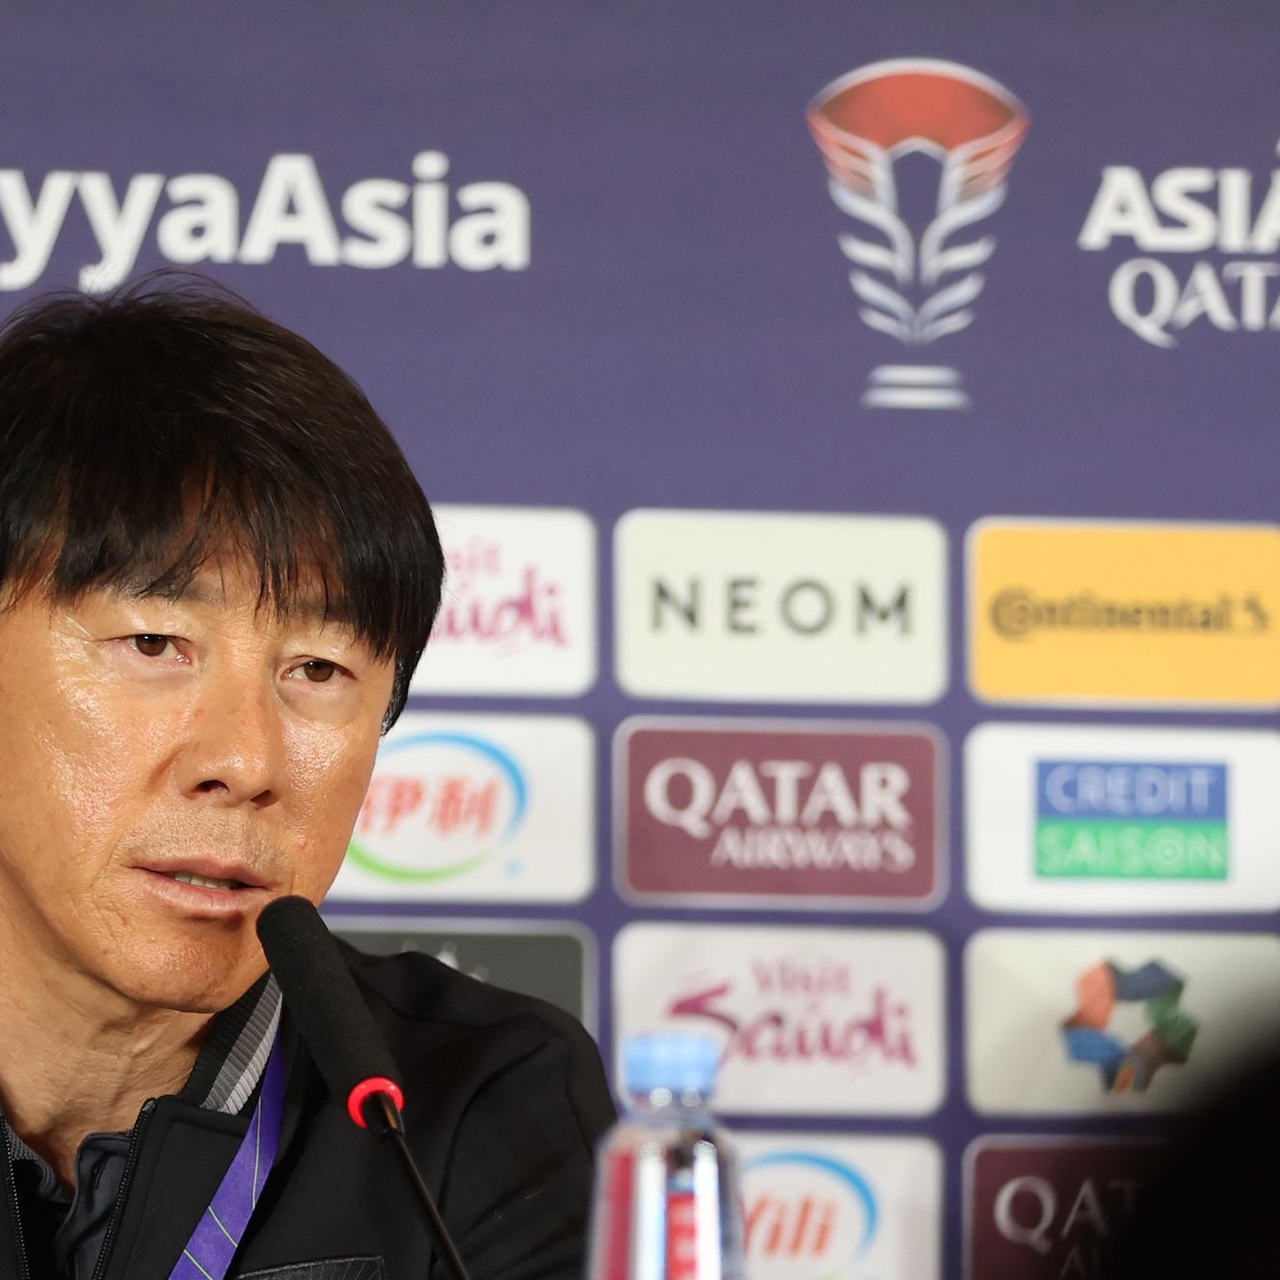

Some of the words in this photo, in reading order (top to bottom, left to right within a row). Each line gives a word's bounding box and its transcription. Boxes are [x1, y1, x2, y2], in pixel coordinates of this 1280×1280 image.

[647, 574, 914, 638] NEOM
[989, 585, 1235, 642] Continental
[642, 756, 913, 841] QATAR
[1045, 764, 1220, 814] CREDIT
[710, 825, 917, 874] AIRWAYS
[1037, 822, 1226, 874] SAISON
[748, 952, 851, 995] Visit
[993, 1175, 1147, 1256] QAT
